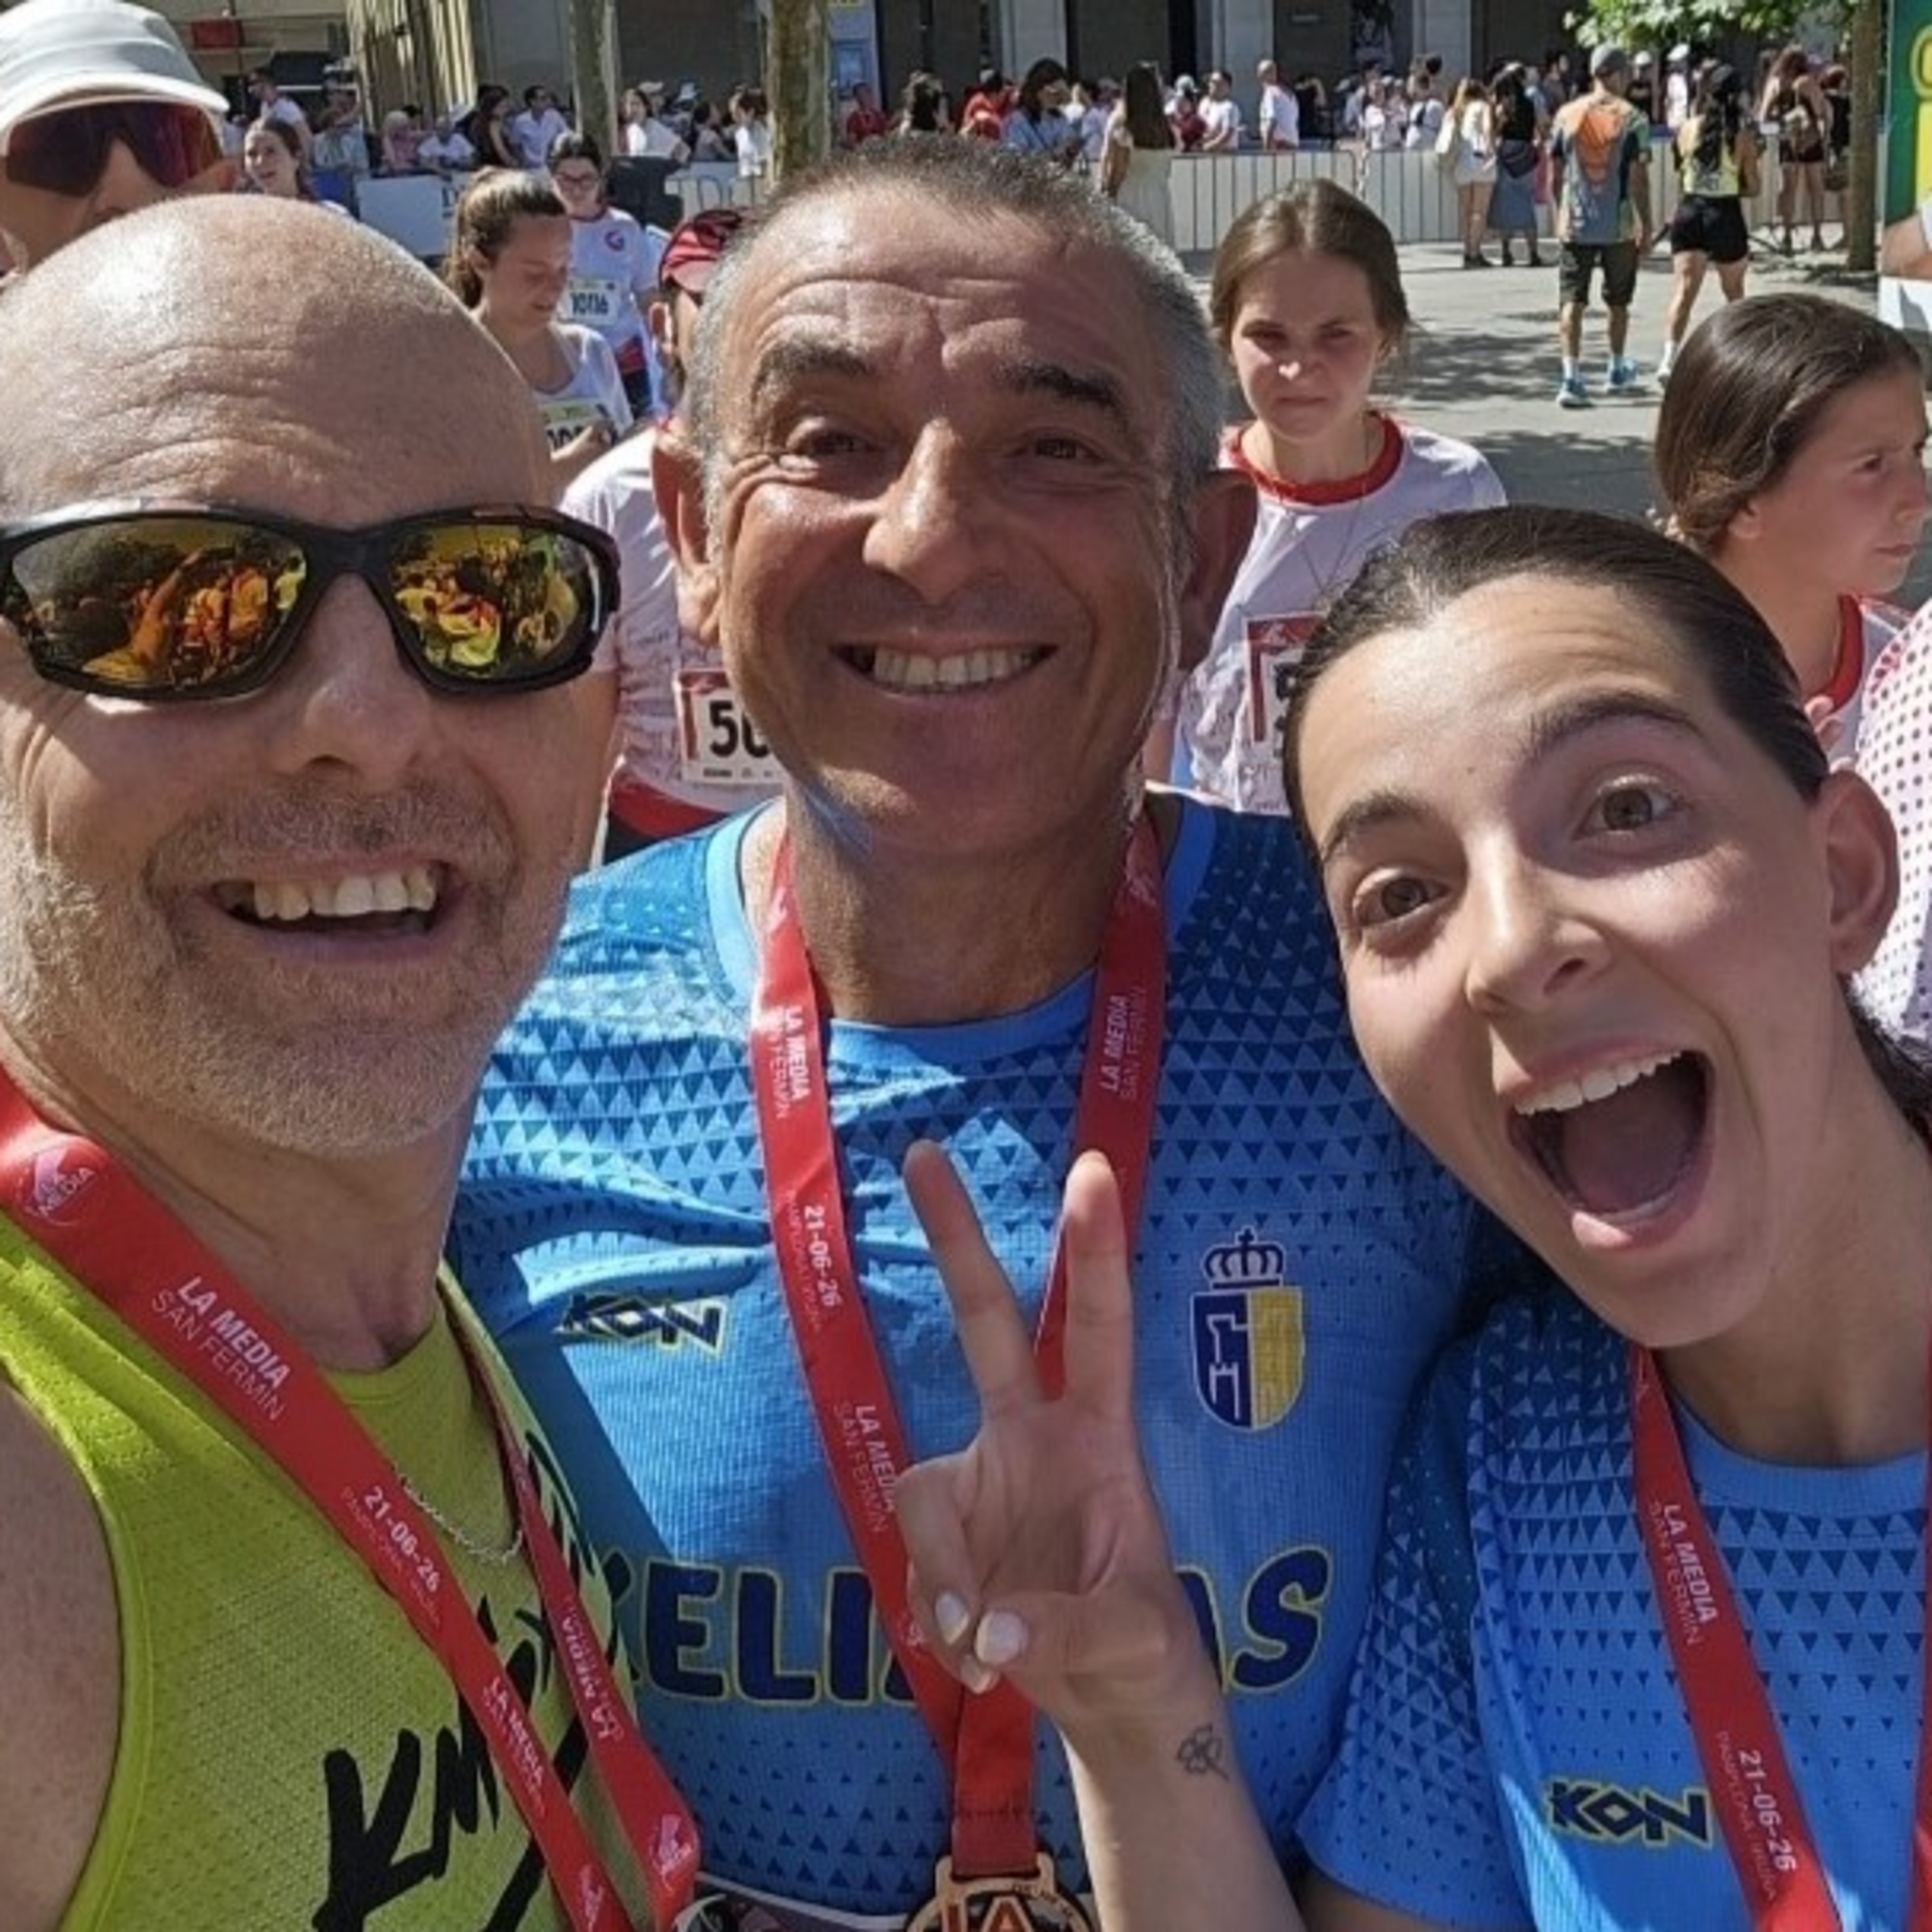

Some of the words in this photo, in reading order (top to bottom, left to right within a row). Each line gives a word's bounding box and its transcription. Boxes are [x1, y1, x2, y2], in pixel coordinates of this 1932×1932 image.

[785, 1005, 804, 1030] LA
[1103, 996, 1128, 1059] MEDIA
[786, 1034, 811, 1099] MEDIA
[1099, 1065, 1121, 1092] LA
[804, 1205, 844, 1307] 21-06-26
[152, 1289, 204, 1341] SAN
[198, 1335, 285, 1420] FERMIN
[178, 1276, 218, 1315] LA
[209, 1309, 290, 1388] MEDIA
[562, 1291, 726, 1355] KON
[855, 1406, 880, 1434] LA
[364, 1485, 440, 1592] 21-06-26
[1663, 1504, 1687, 1535] LA
[1675, 1542, 1718, 1623] MEDIA
[1549, 1779, 1712, 1846] KON
[1738, 1749, 1797, 1872] 21-06-26
